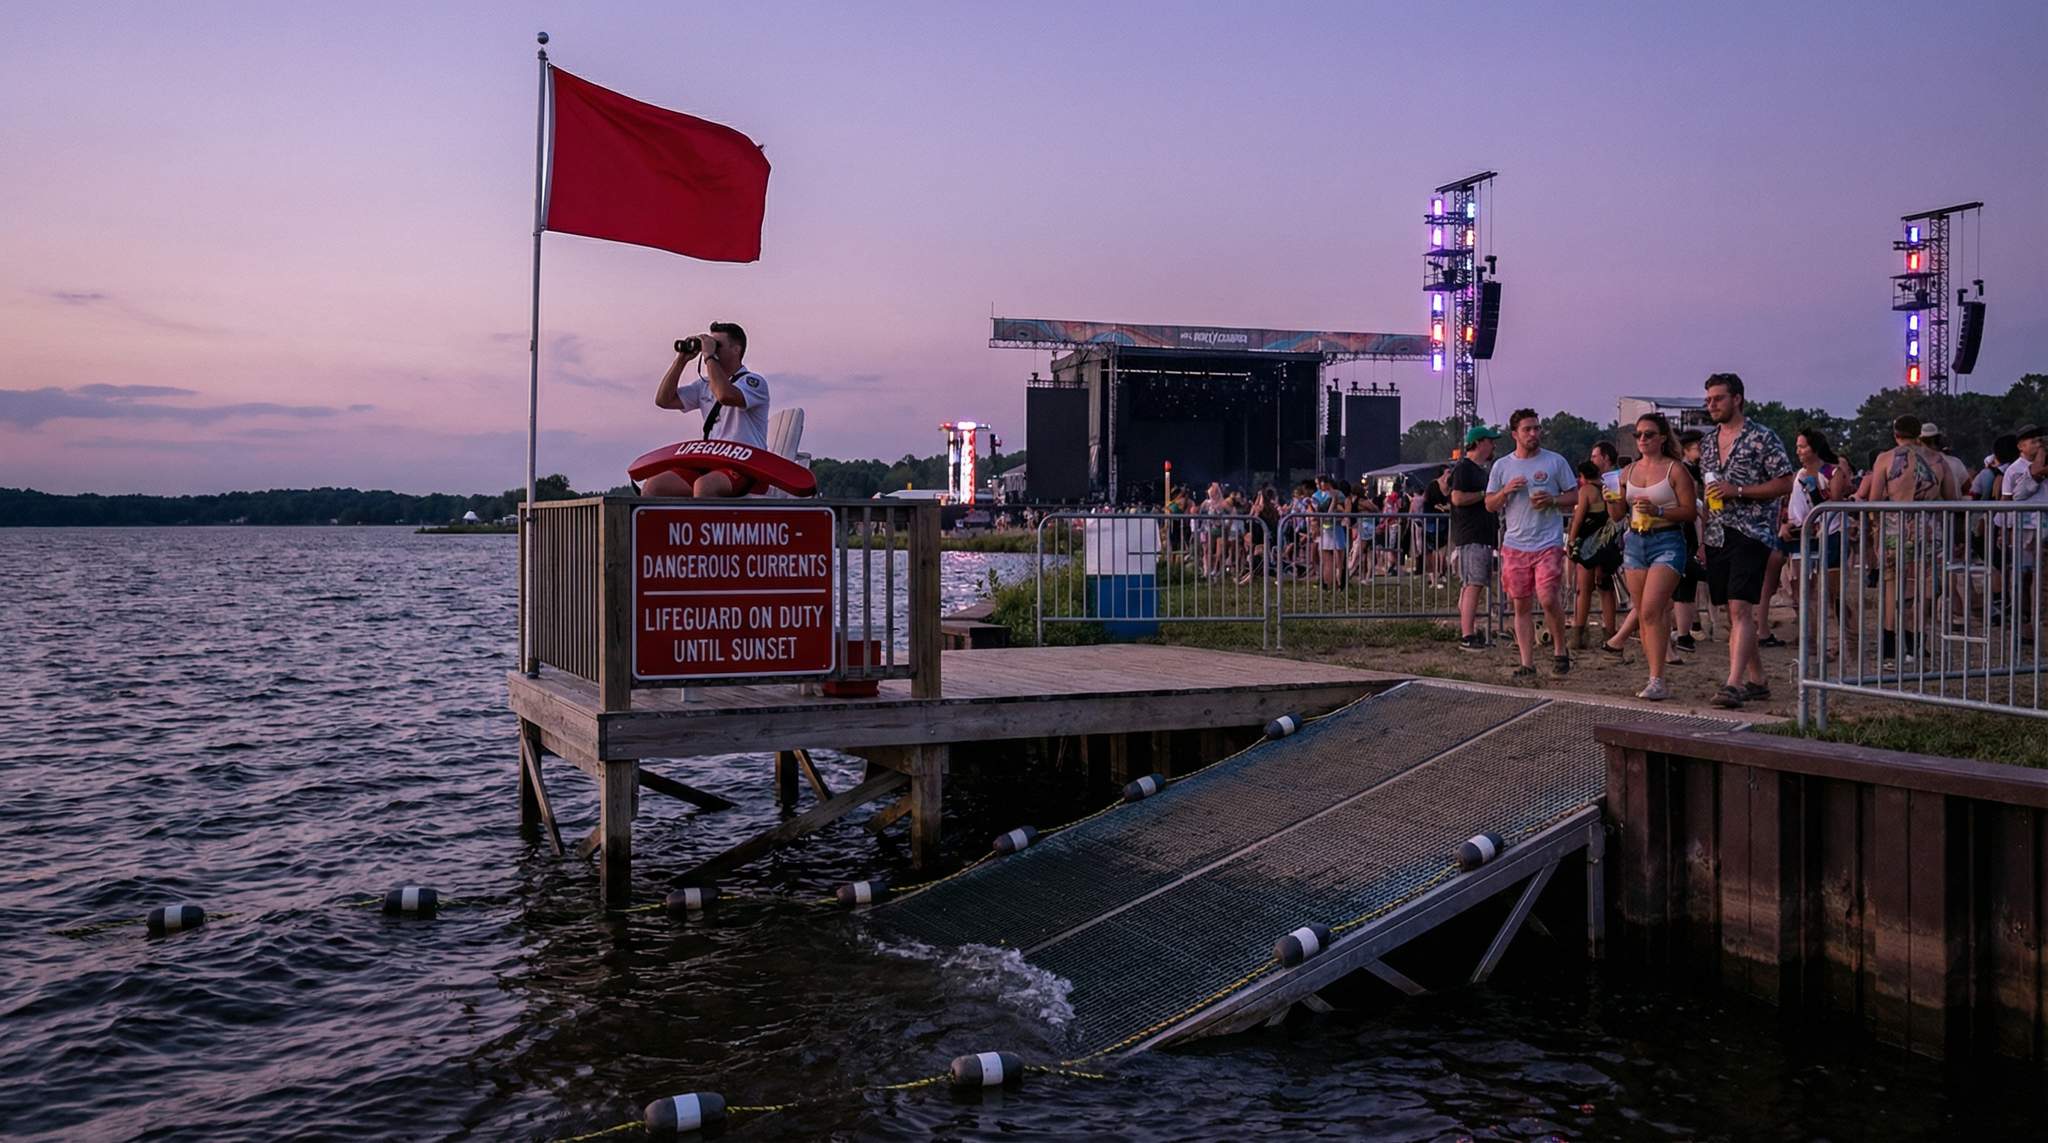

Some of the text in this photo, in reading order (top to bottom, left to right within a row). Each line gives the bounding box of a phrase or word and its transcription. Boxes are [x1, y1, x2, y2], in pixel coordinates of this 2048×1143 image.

[674, 442, 752, 461] LIFEGUARD
[669, 522, 693, 546] NO
[700, 522, 790, 546] SWIMMING
[643, 553, 827, 579] DANGEROUS CURRENTS
[645, 605, 824, 631] LIFEGUARD ON DUTY
[674, 636, 797, 663] UNTIL SUNSET
